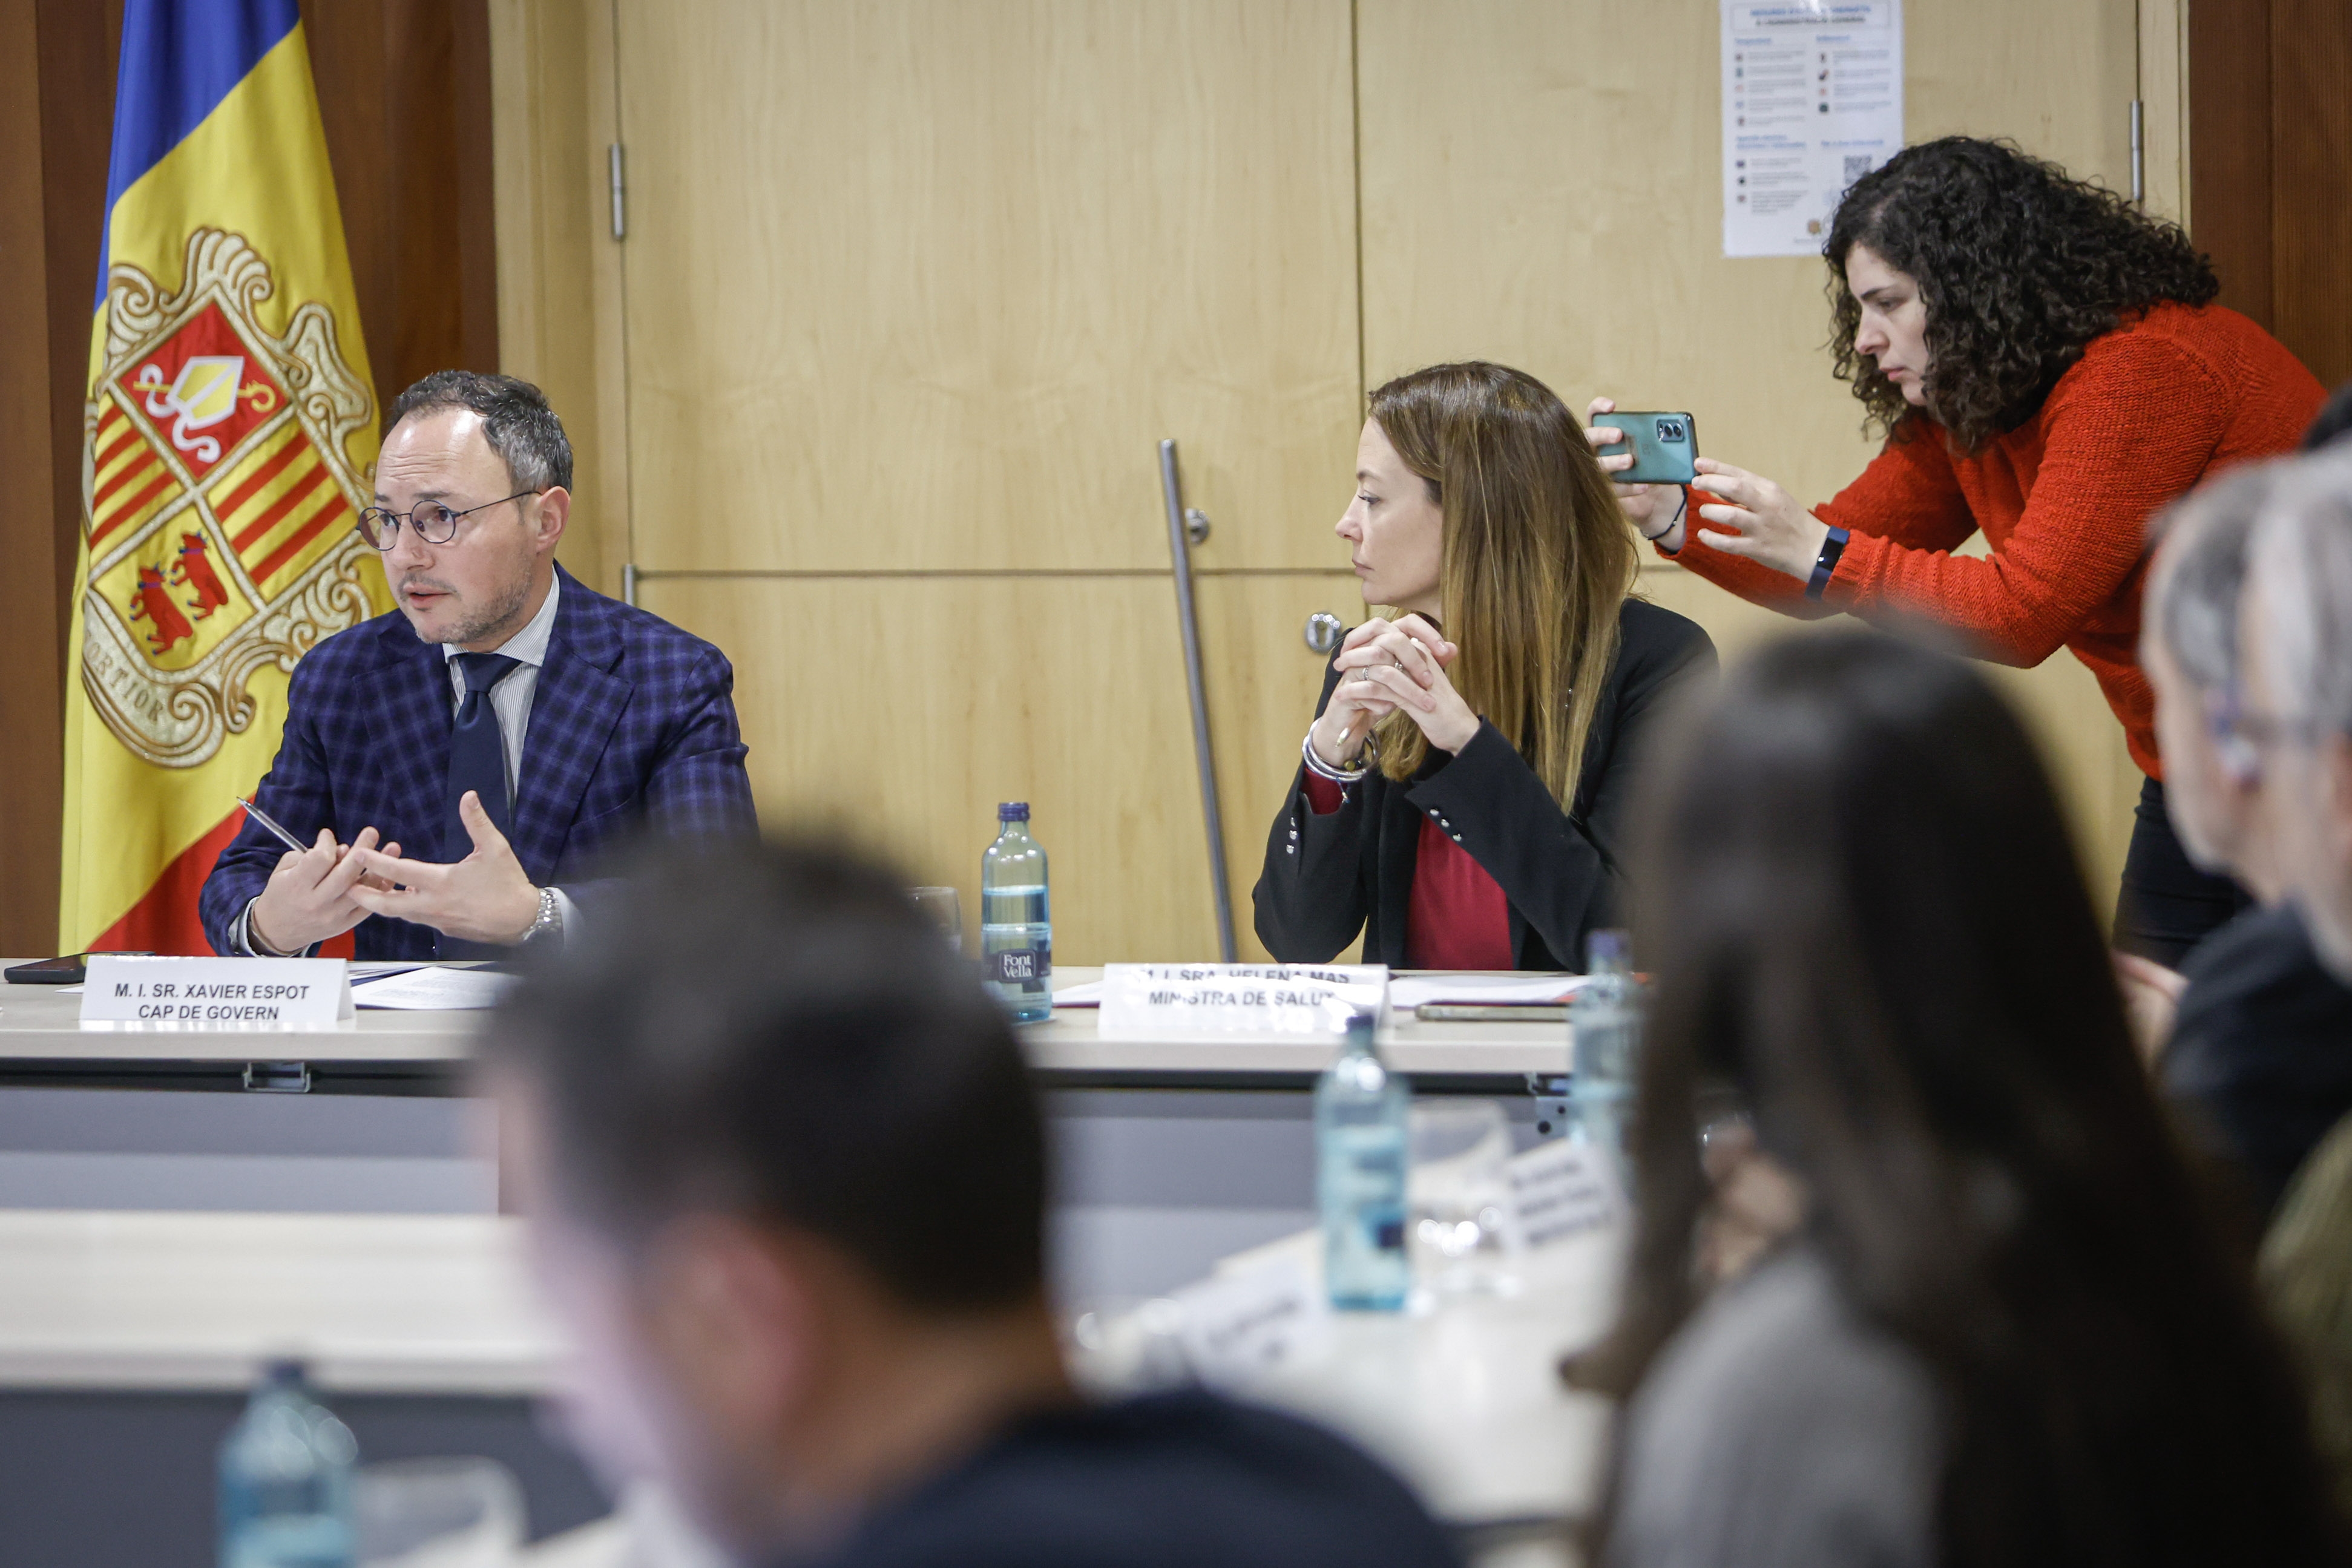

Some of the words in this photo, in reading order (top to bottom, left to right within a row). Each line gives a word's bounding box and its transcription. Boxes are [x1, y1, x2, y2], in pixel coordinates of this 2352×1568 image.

[1004, 954, 1031, 966] Font
[1004, 964, 1032, 978] Vella
[114, 983, 133, 997] M.
[138, 983, 146, 997] I.
[153, 983, 179, 998] SR.
[184, 984, 247, 999] XAVIER
[252, 985, 310, 999] ESPOT
[1149, 991, 1237, 1005] MINSTRA
[1243, 991, 1267, 1006] DE
[139, 1005, 174, 1019] CAP
[179, 1005, 202, 1019] DE
[207, 1006, 280, 1020] GOVERN
